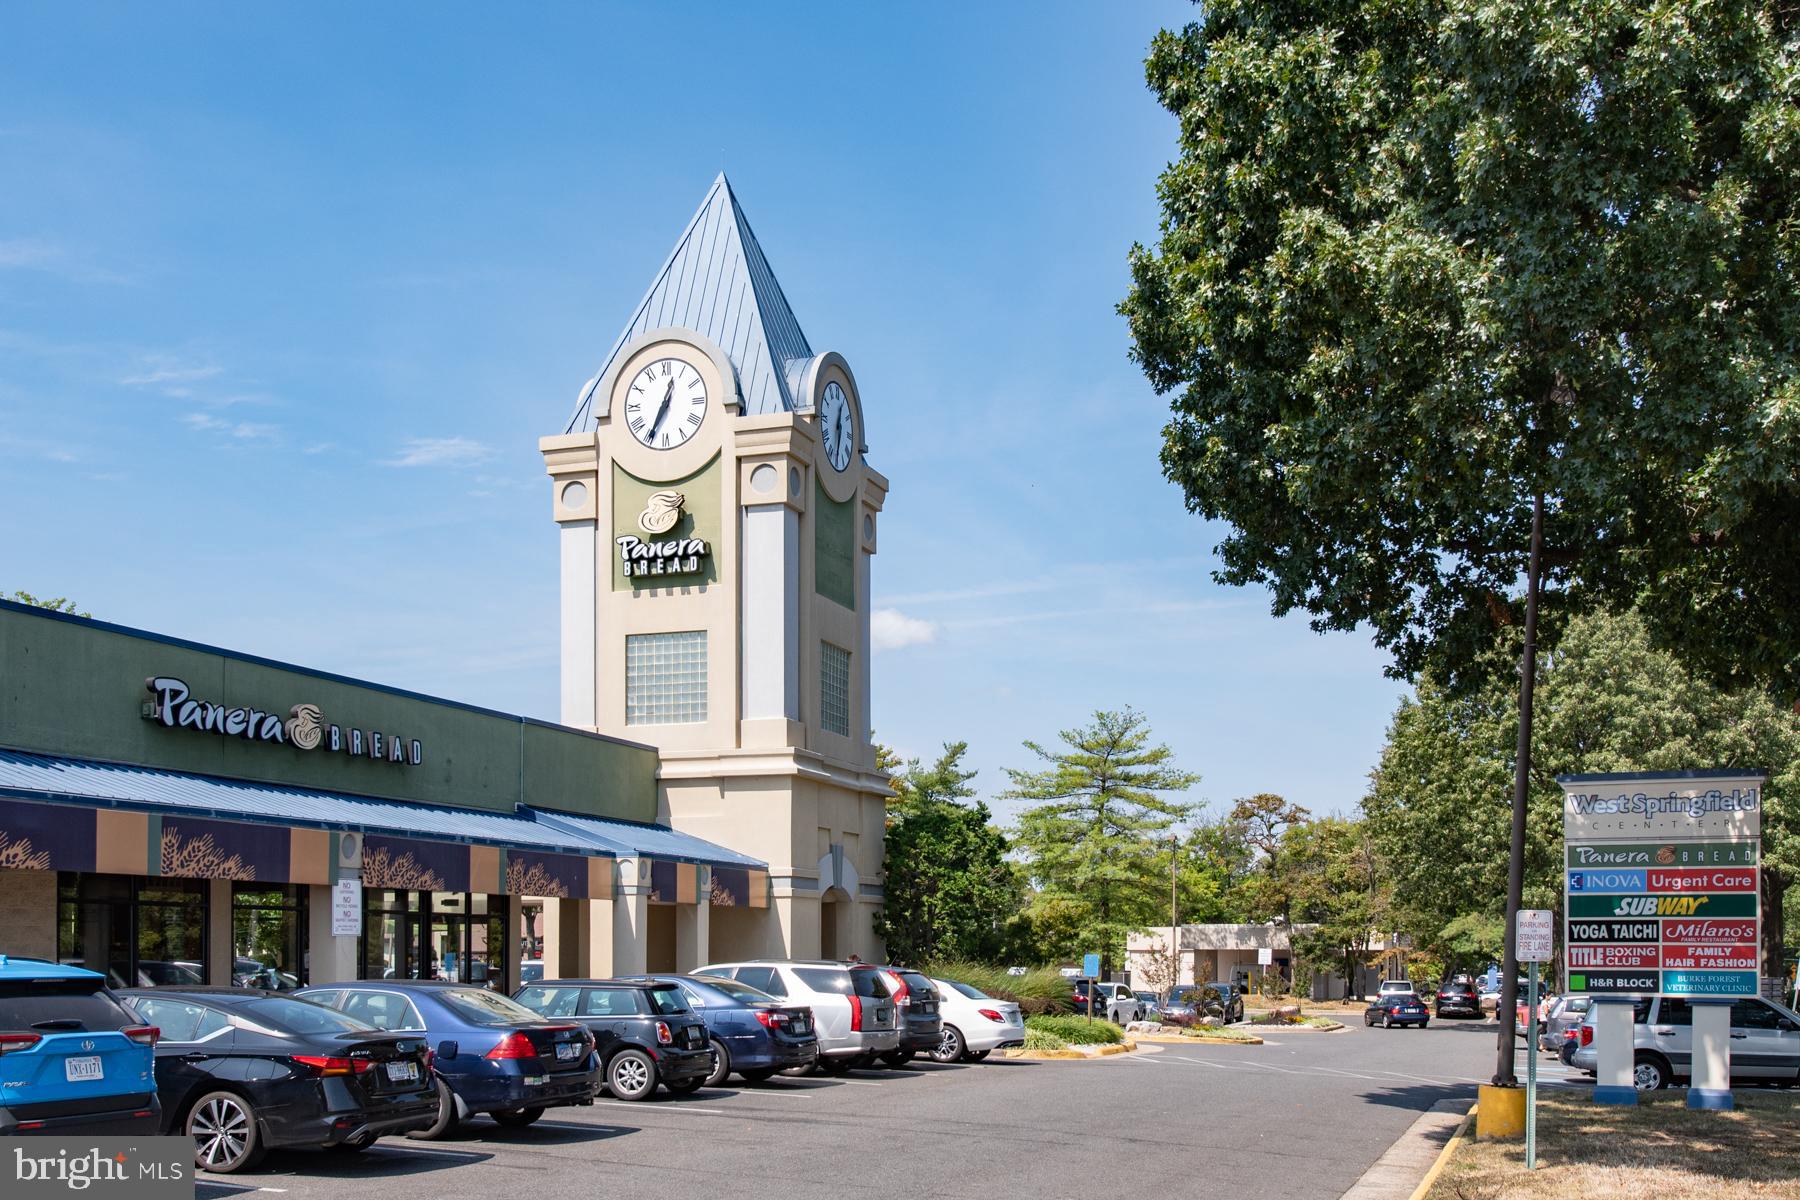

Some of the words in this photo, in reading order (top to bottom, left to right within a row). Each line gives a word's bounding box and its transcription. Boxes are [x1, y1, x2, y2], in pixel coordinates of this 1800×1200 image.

[616, 535, 704, 560] Panera
[623, 556, 698, 576] BREAD
[154, 677, 284, 743] Panera
[331, 724, 422, 765] BREAD
[1569, 794, 1630, 815] West
[1632, 788, 1757, 819] Springfield
[1576, 847, 1650, 864] Panera
[1682, 851, 1751, 862] BREAD
[1586, 875, 1642, 888] INOVA
[1652, 875, 1709, 890] Urgent
[1712, 874, 1752, 887] Care
[1614, 896, 1709, 916] SUBWAY
[1571, 924, 1609, 939] YOGA
[1611, 924, 1657, 939] TAICHI
[1666, 920, 1754, 938] Milano's
[1519, 942, 1531, 951] FIRE
[1533, 942, 1550, 951] LANE
[1688, 947, 1732, 956] FAMILY
[1570, 947, 1604, 965] TITLE
[1606, 947, 1656, 956] BOXING
[1606, 957, 1641, 966] CLUB
[1665, 958, 1696, 967] HAIR
[1700, 958, 1756, 968] FASHION
[1589, 978, 1614, 987] H&R
[1616, 978, 1654, 988] BLOCK
[1677, 975, 1706, 983] BURKE
[1708, 974, 1741, 983] FOREST
[1667, 984, 1720, 992] VETERINARY
[1722, 985, 1752, 993] CLINIC
